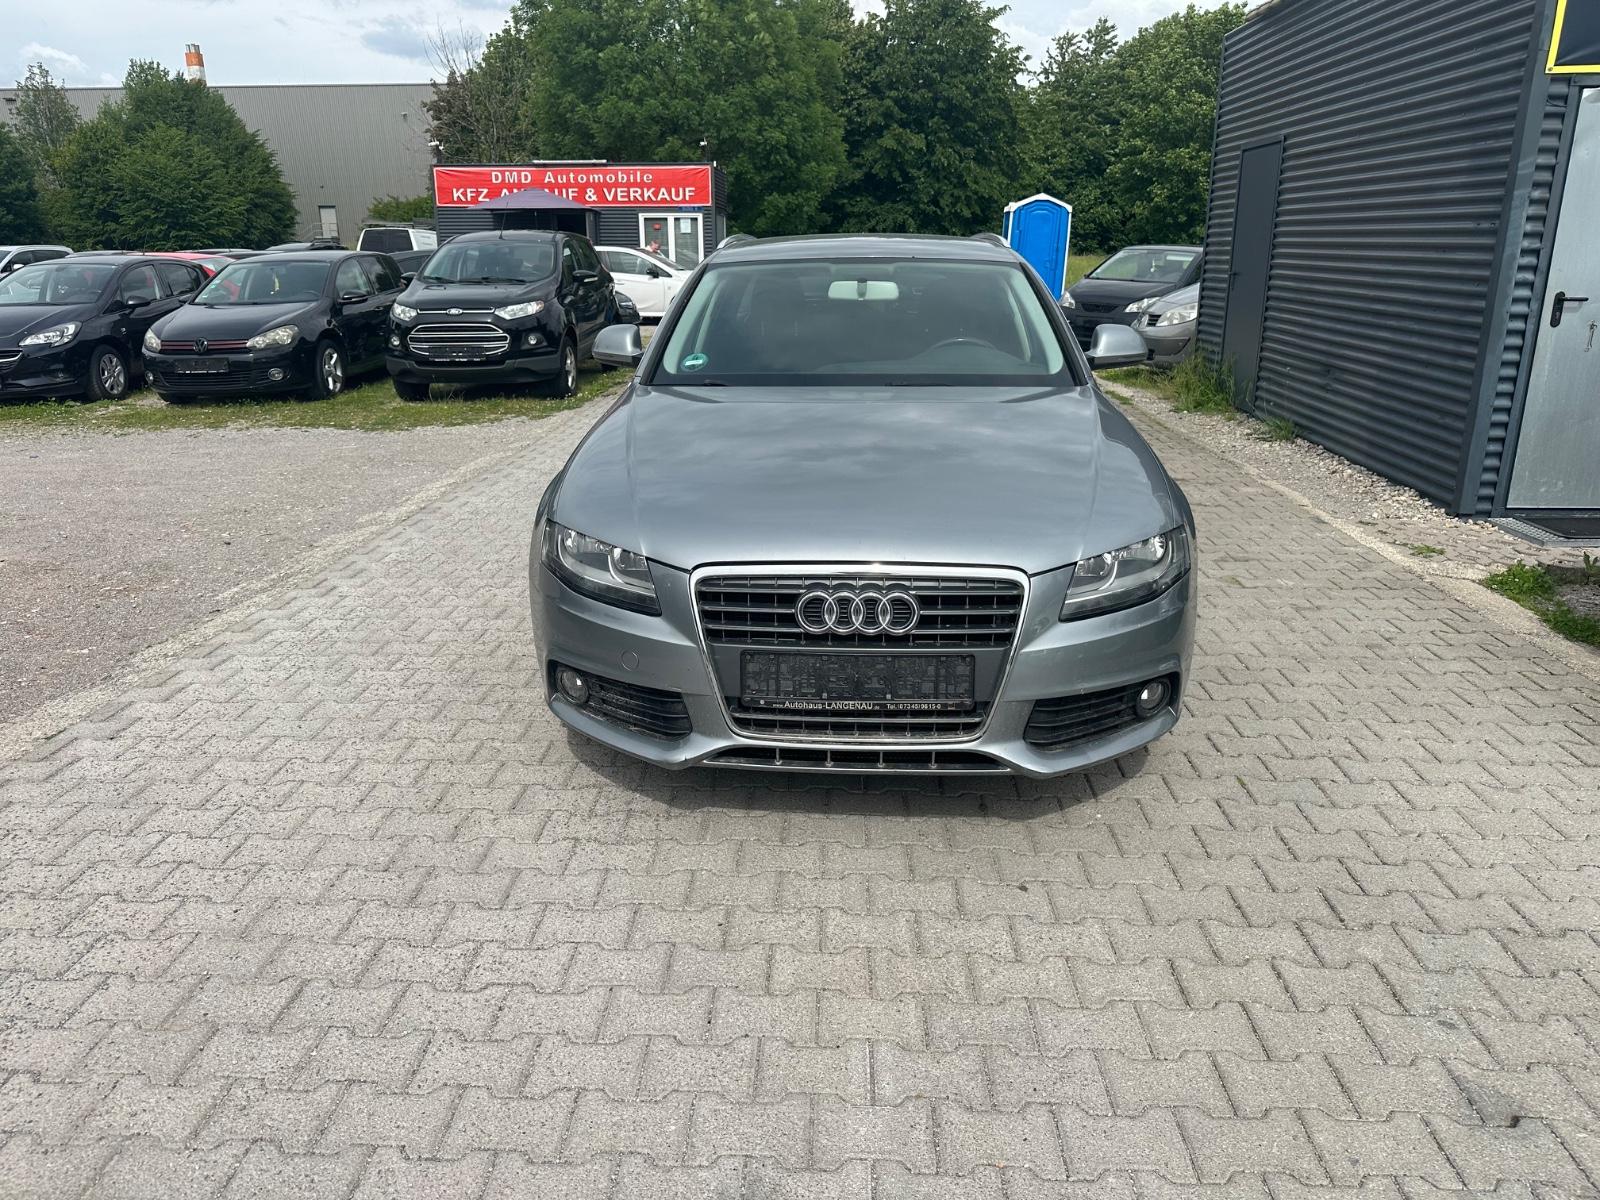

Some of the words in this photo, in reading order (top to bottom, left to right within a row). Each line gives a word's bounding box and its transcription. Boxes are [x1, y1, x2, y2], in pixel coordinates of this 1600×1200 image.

[491, 171, 532, 184] DMD
[544, 171, 654, 184] Automobile
[452, 188, 490, 202] KFZ
[585, 187, 598, 202] &
[603, 187, 696, 202] VERKAUF
